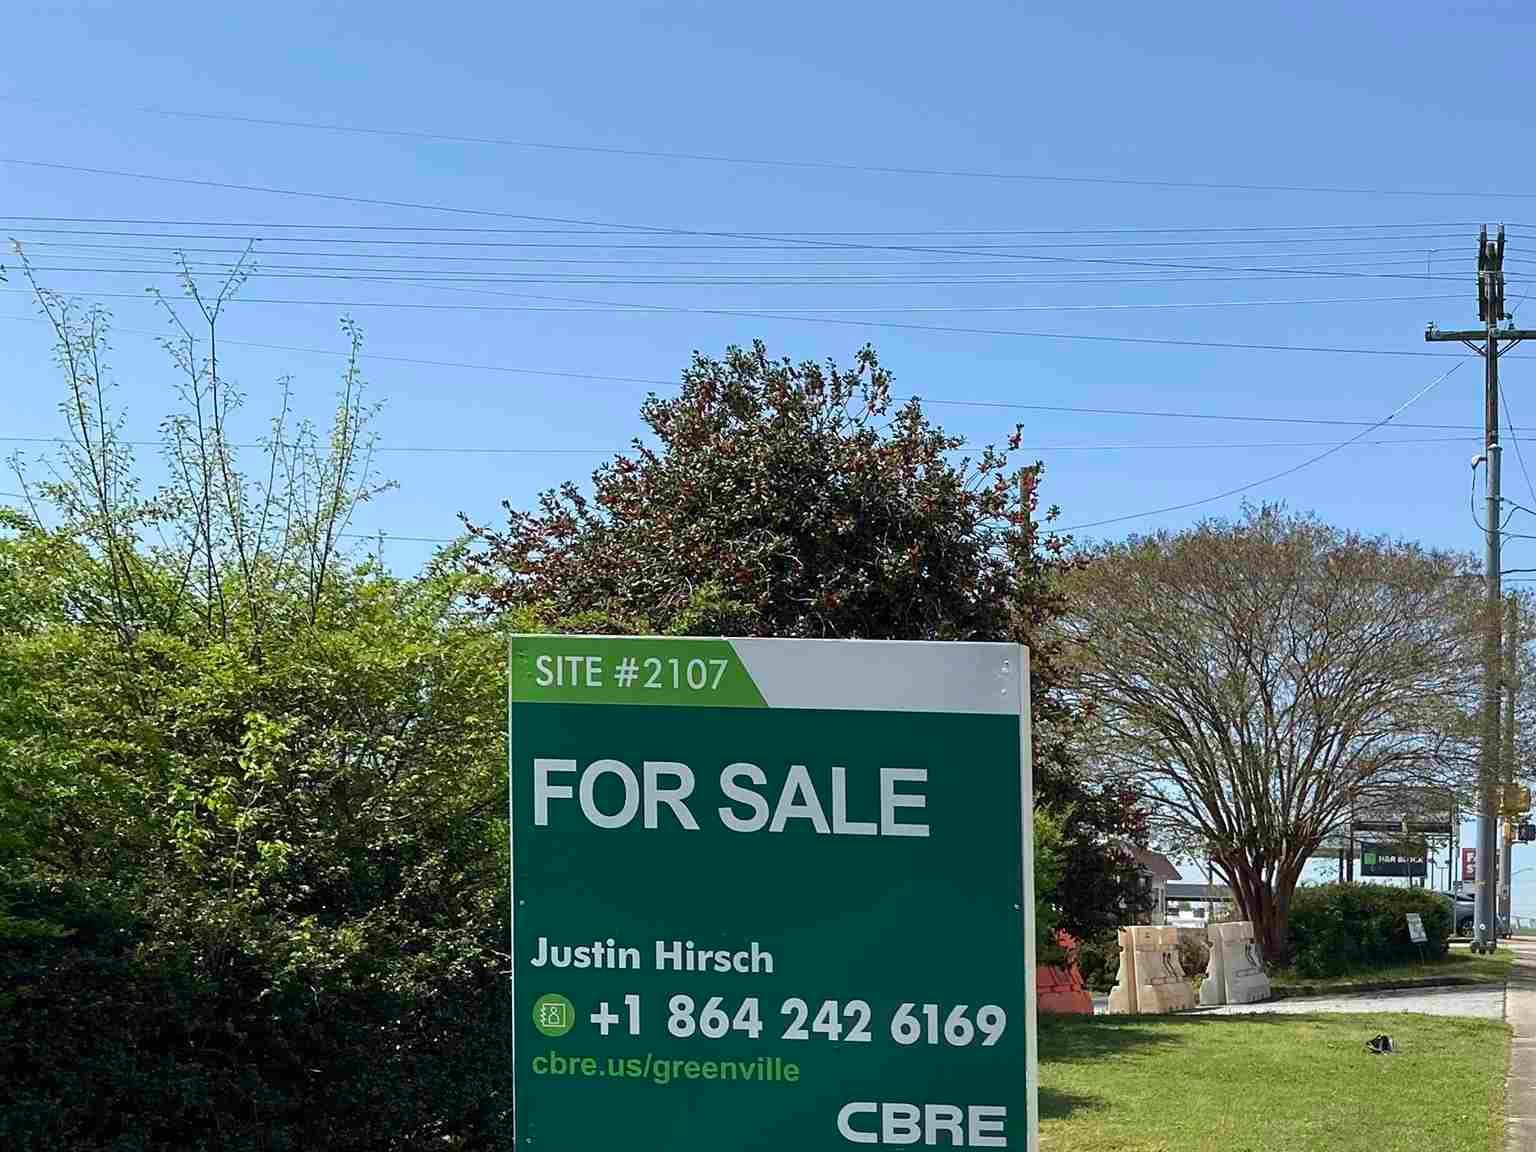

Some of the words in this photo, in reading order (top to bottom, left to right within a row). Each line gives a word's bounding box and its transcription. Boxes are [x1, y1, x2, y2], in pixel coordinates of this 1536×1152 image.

[535, 655, 602, 688] SITE
[614, 657, 729, 690] #2107
[533, 758, 701, 831] FOR
[718, 763, 931, 838] SALE
[530, 937, 641, 971] Justin
[655, 940, 775, 974] Hirsch
[590, 994, 641, 1036] +1
[667, 994, 764, 1040] 864
[780, 997, 873, 1043] 242
[890, 1002, 1008, 1047] 6169
[531, 1052, 801, 1086] cbre.us/greenville
[836, 1102, 1009, 1148] CBRE
